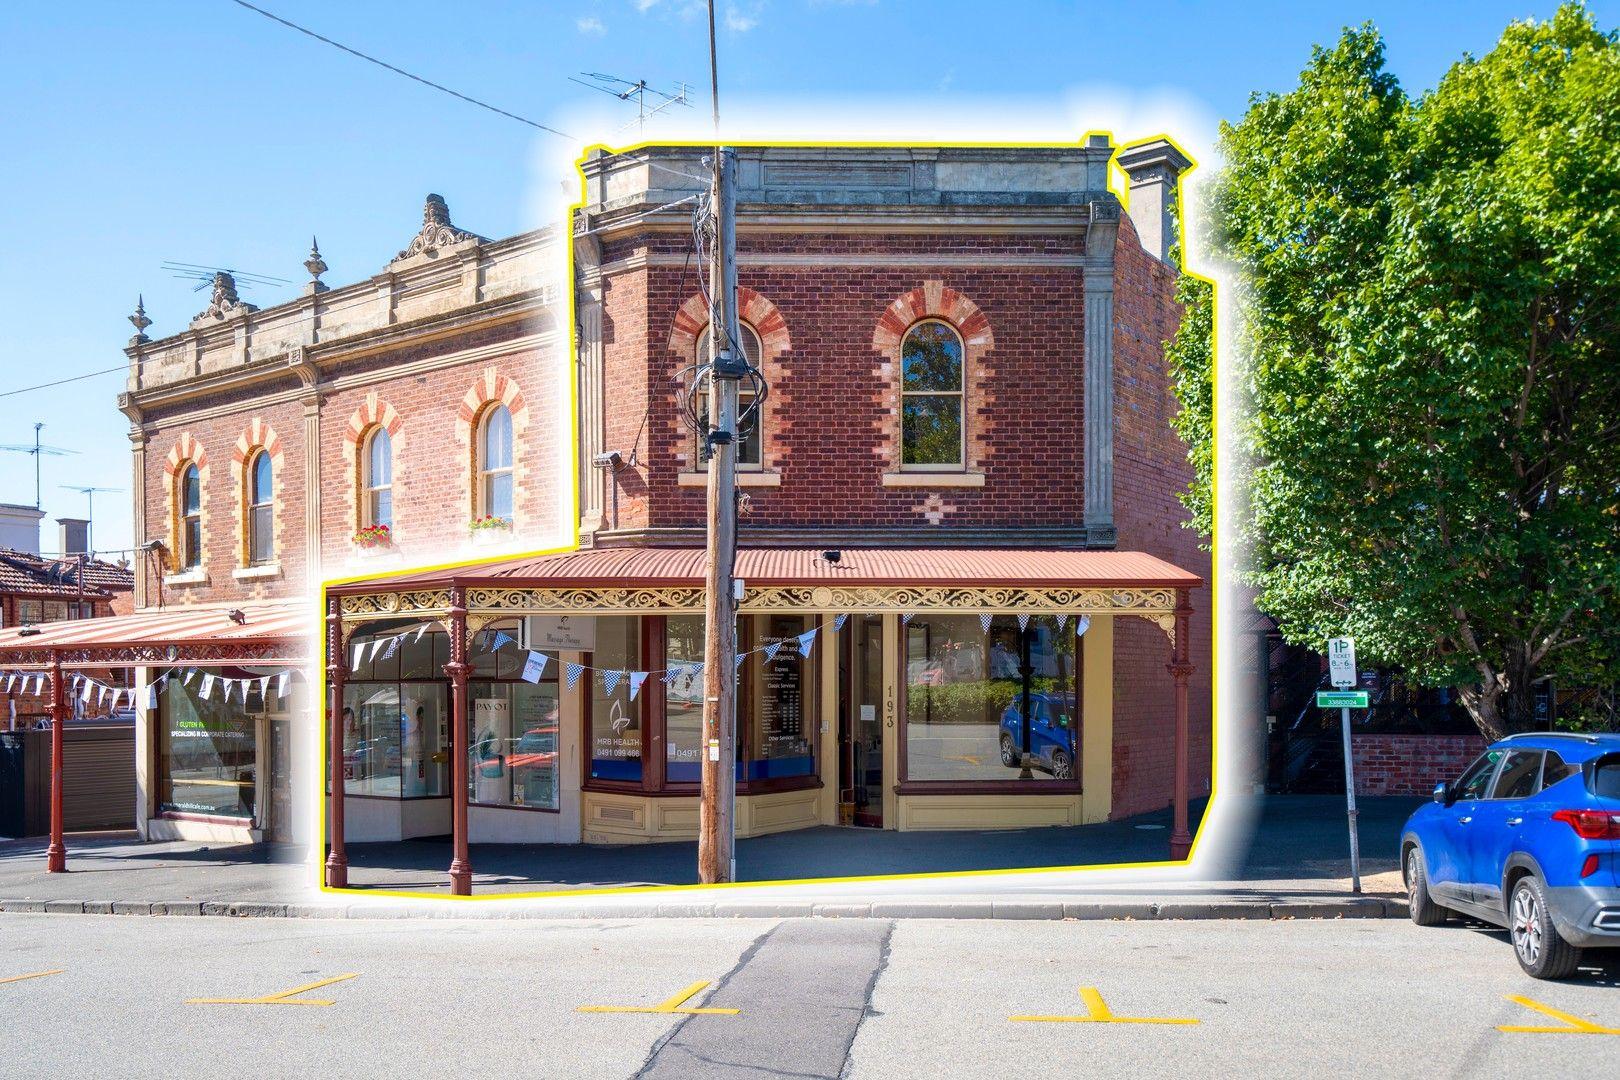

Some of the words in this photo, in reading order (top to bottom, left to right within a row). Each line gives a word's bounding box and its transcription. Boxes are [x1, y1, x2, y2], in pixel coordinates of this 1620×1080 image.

[1334, 641, 1349, 653] 1P
[476, 703, 507, 711] PAYOT
[597, 738, 611, 746] MRB
[613, 738, 640, 746] HEALTH
[677, 749, 698, 757] 0491
